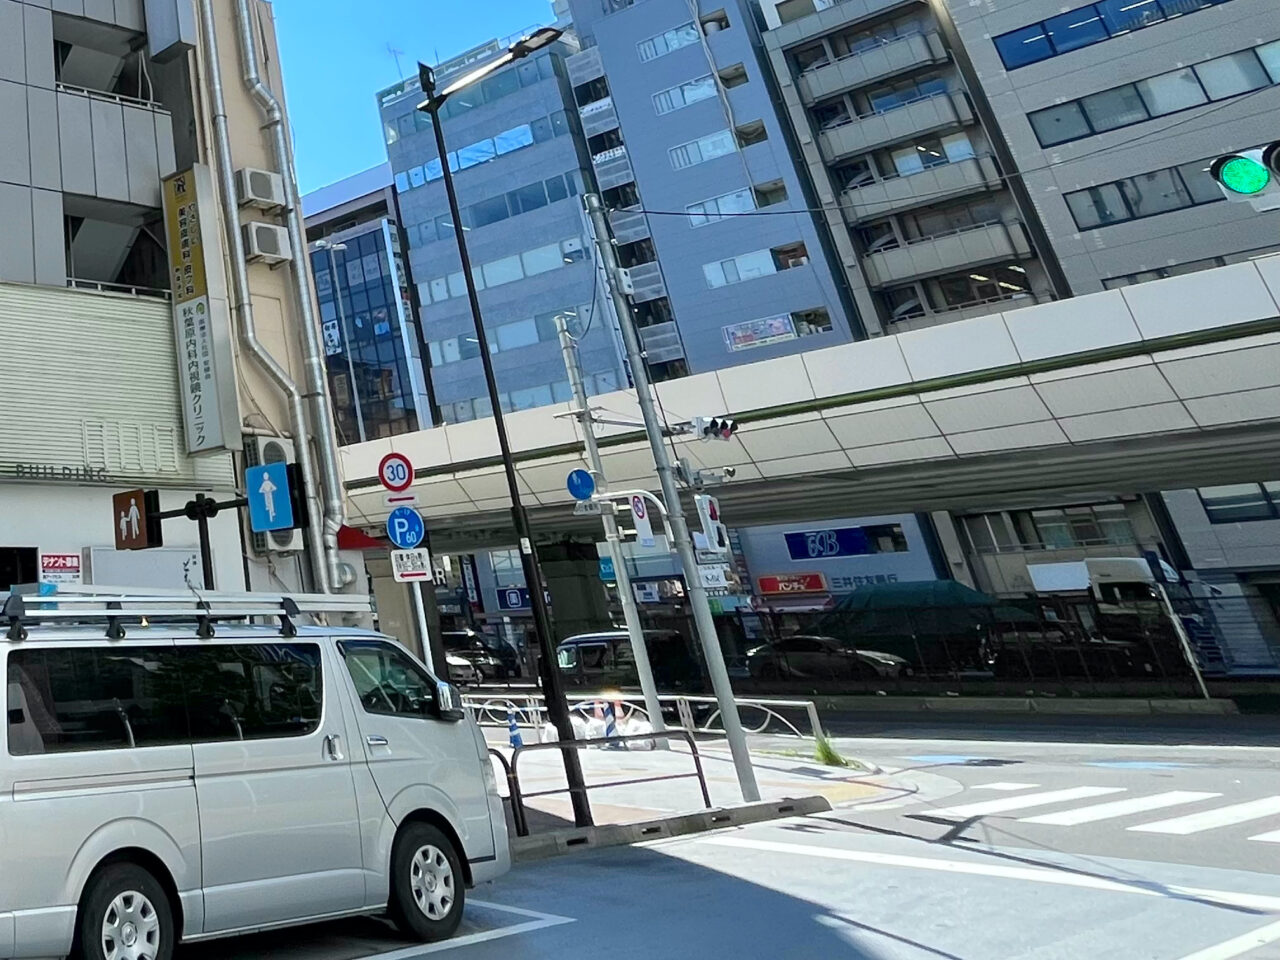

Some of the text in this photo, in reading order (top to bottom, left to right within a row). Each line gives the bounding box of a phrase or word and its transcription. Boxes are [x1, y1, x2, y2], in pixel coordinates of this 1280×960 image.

[182, 306, 207, 448] 秋葉原内科内視鏡クリニック
[16, 463, 113, 483] BUILDING
[386, 463, 406, 482] 30
[393, 518, 409, 545] P
[42, 556, 80, 568] テナント募集
